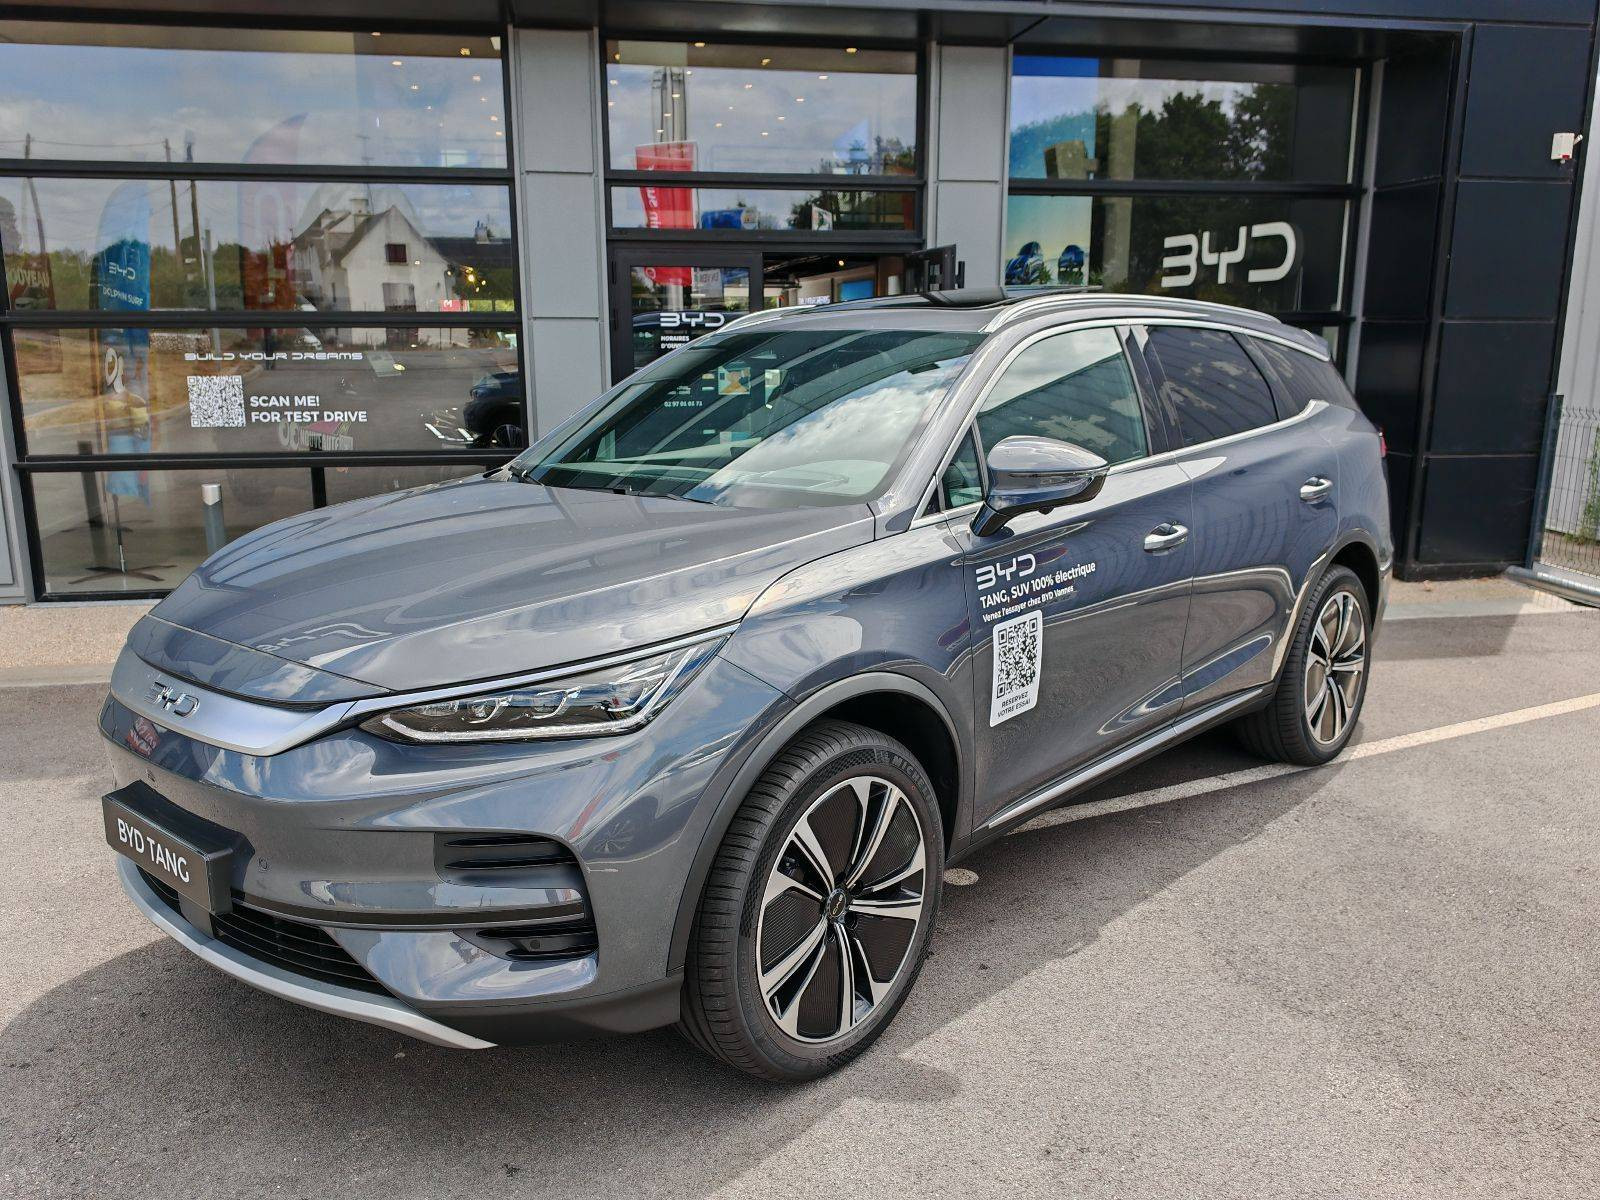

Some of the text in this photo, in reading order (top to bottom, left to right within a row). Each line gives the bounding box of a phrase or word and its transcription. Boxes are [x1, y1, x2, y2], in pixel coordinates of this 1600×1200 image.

[1161, 222, 1296, 288] BYD
[108, 262, 136, 280] BYD
[660, 312, 725, 327] BYD
[184, 352, 363, 361] BUILD YOUR DREAMS
[250, 396, 320, 407] SCAN ME!
[251, 411, 367, 423] FOR TEST DRIVE
[975, 553, 1036, 591] BYD
[980, 561, 1096, 609] TANG, SUV 100% électrique
[982, 584, 1075, 623] Venez l'essayer chez BYD Vannes
[146, 681, 201, 718] BYD
[997, 704, 1015, 718] VOTRE
[117, 817, 190, 883] BYD TANG
